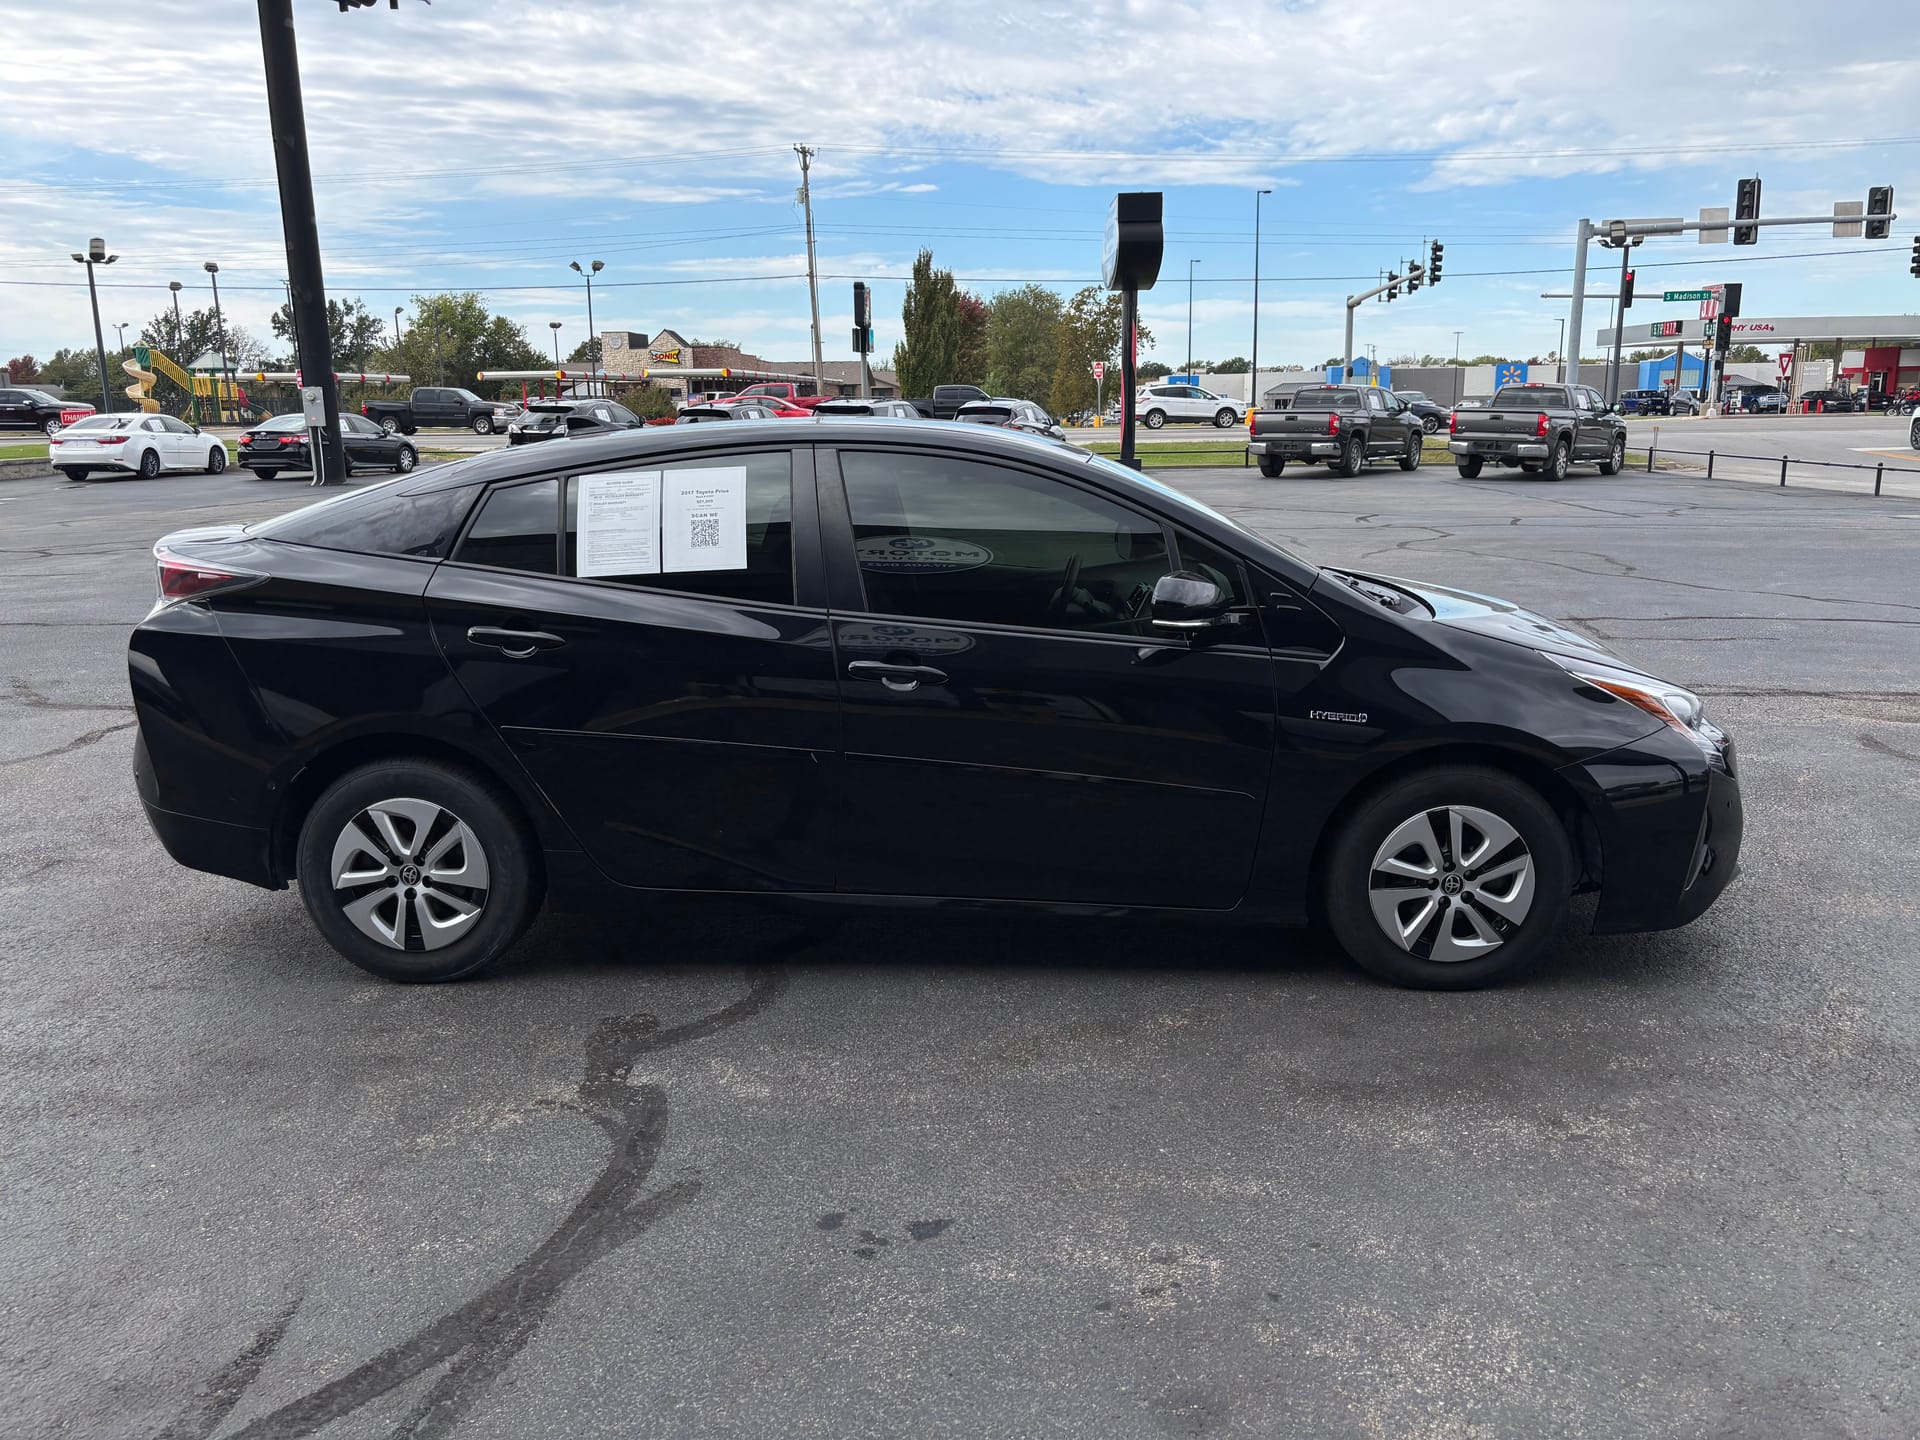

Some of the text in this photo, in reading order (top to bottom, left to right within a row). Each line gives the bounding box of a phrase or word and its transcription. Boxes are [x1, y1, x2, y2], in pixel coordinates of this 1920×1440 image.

[1673, 292, 1701, 300] Madison
[1749, 323, 1769, 331] USA
[1310, 710, 1366, 722] HYBRID
